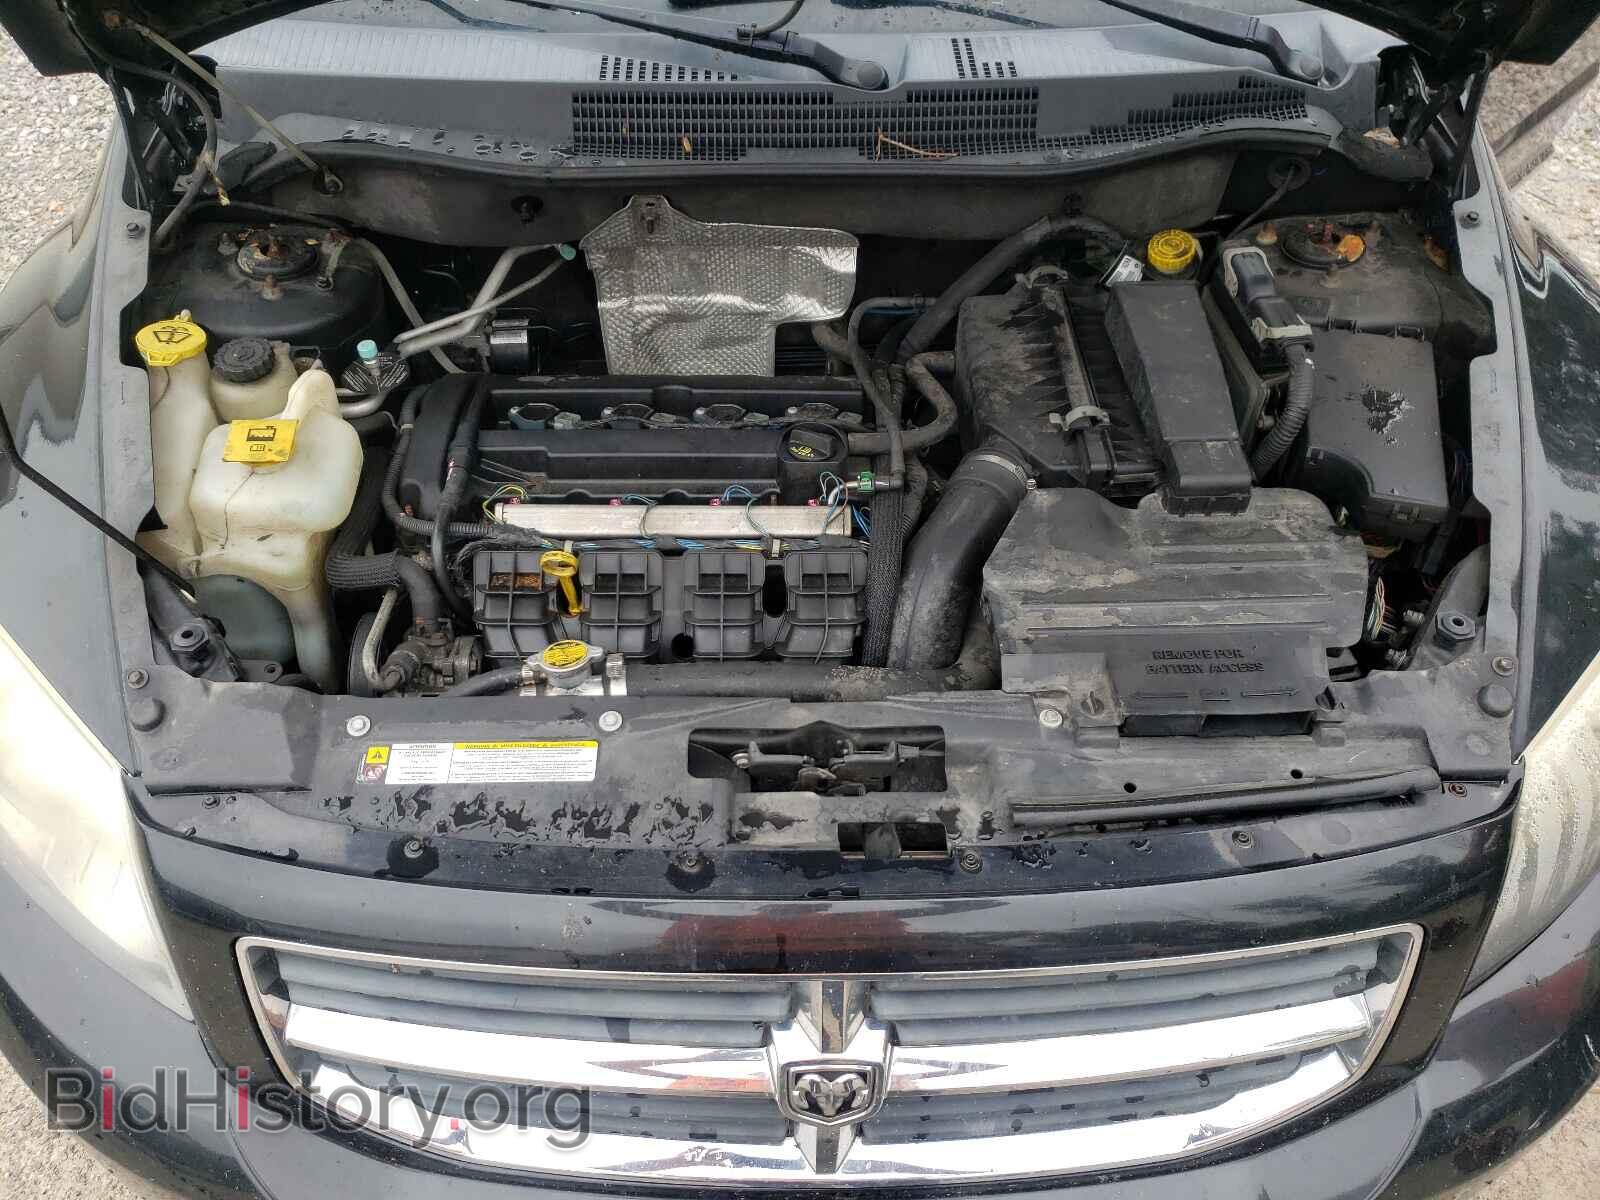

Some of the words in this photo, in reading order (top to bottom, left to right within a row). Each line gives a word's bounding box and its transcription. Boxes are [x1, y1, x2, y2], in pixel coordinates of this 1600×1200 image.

[1152, 649, 1212, 660] REMOVE
[1145, 663, 1205, 675] BATTERY
[1208, 661, 1264, 674] ACCESS
